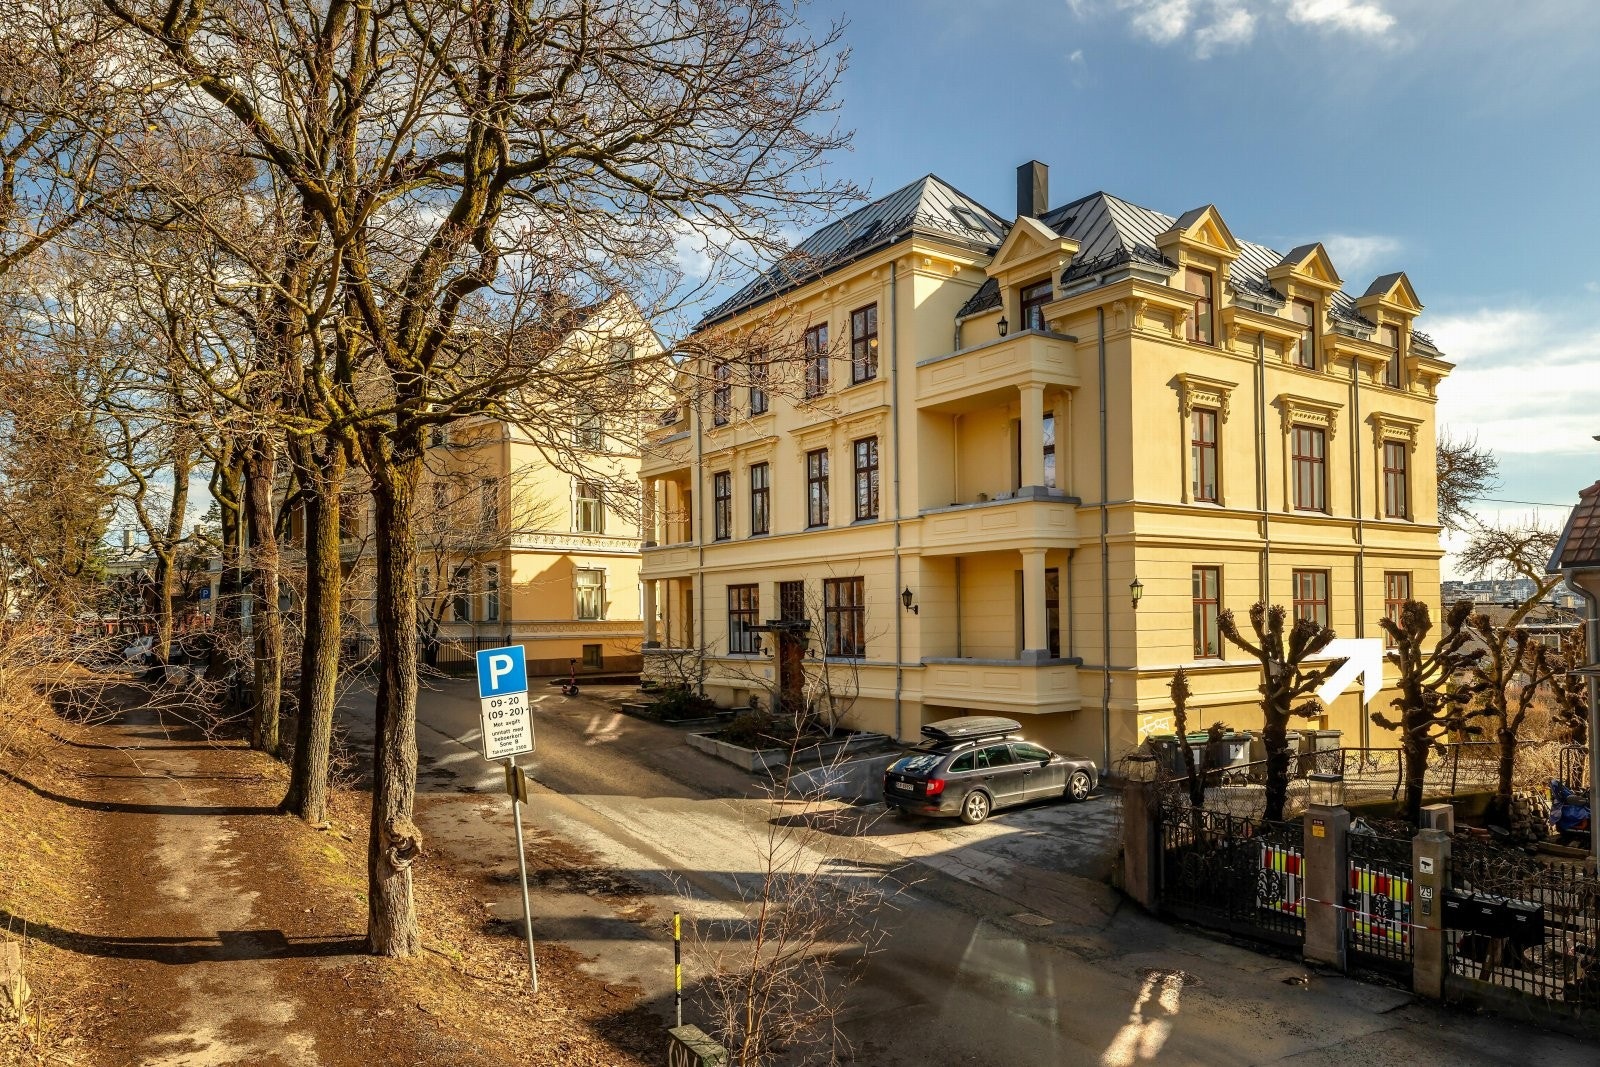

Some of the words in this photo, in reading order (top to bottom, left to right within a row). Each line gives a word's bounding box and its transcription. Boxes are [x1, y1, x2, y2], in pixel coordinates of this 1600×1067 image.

[202, 589, 209, 598] P
[489, 654, 514, 690] P
[494, 733, 522, 742] beboerkort
[1420, 886, 1432, 897] 29
